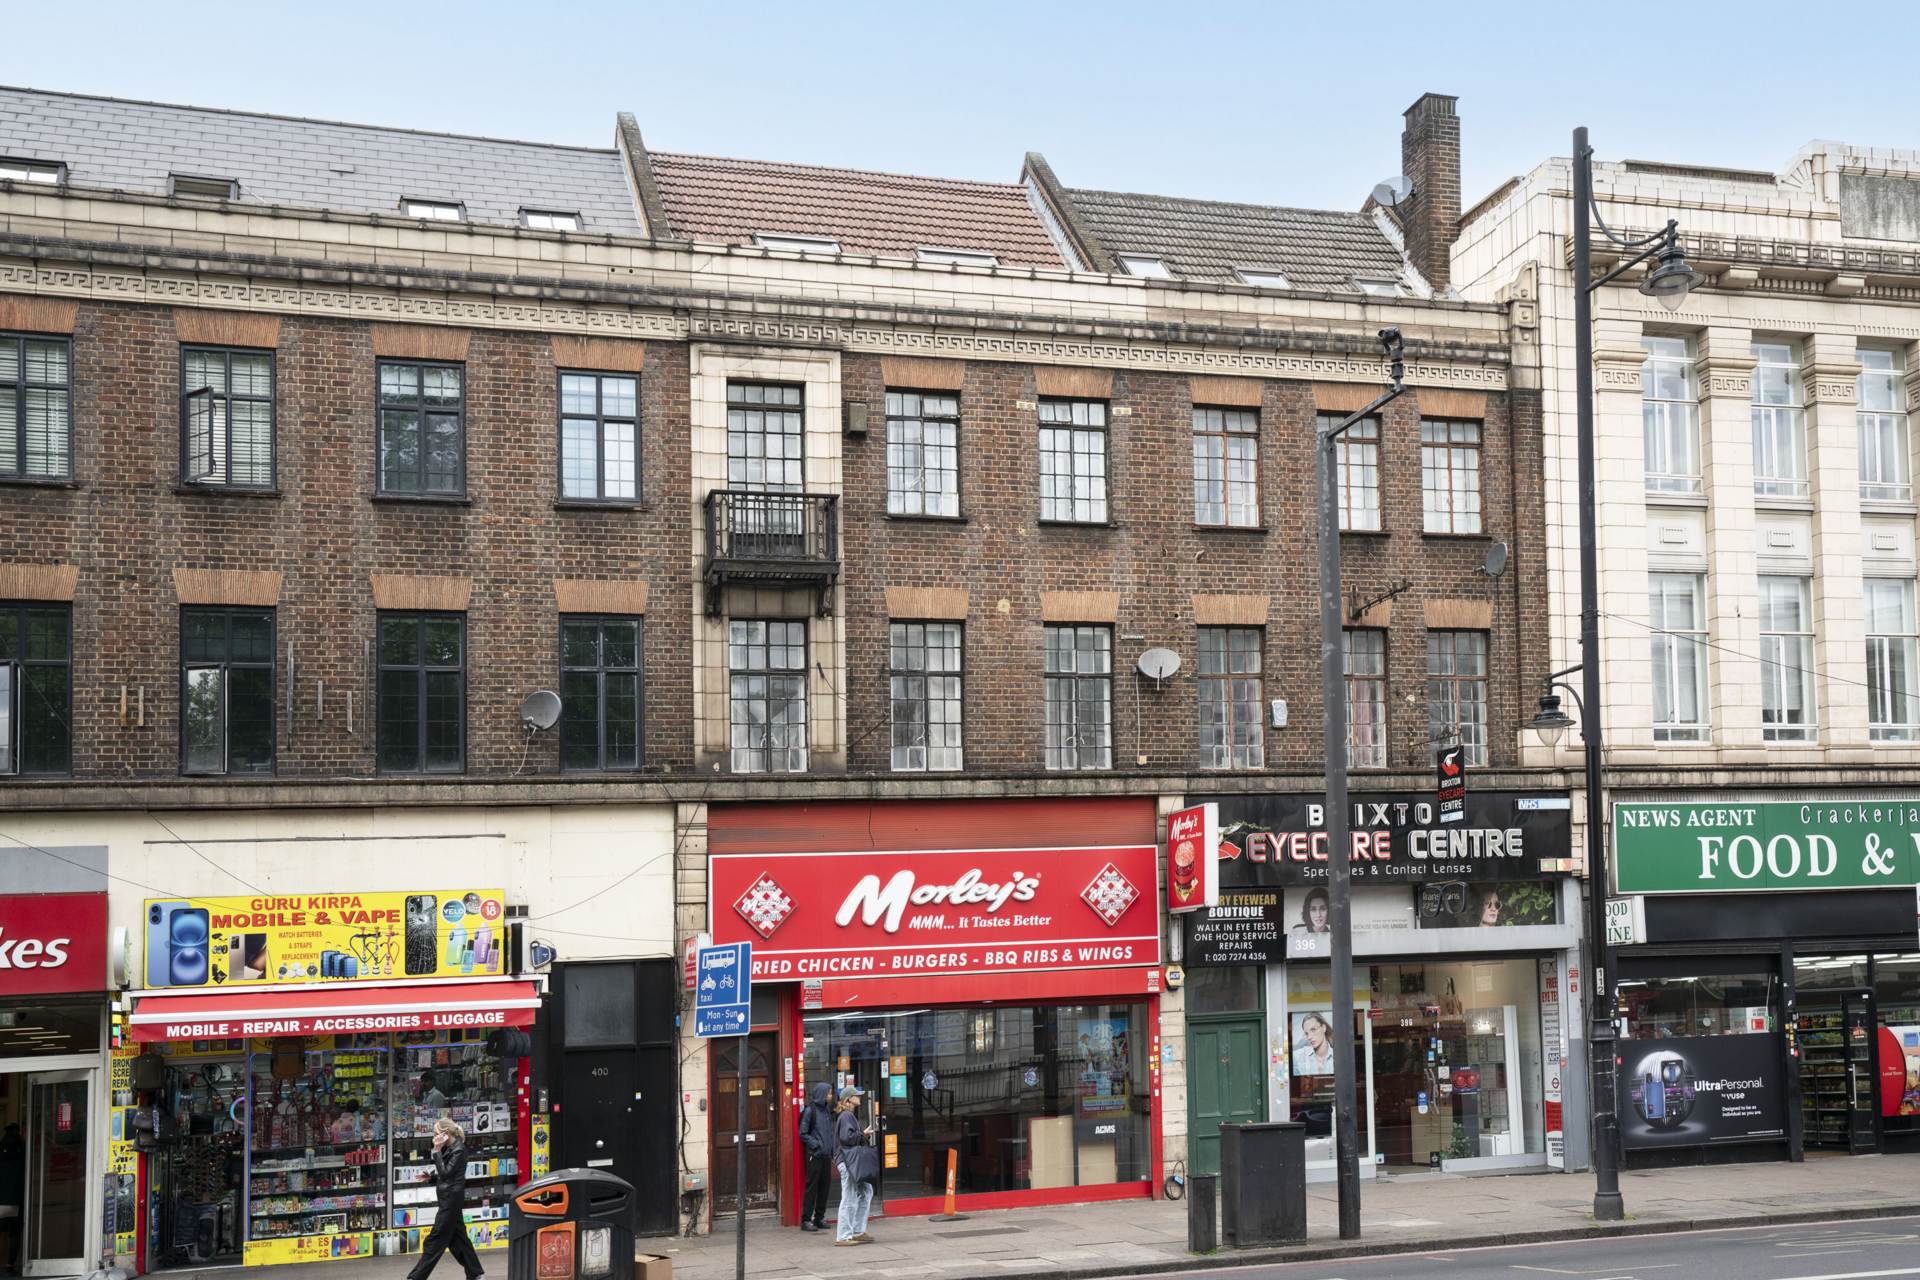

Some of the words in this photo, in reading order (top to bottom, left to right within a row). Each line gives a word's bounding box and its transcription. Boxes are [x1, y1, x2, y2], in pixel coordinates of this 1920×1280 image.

[1439, 788, 1465, 800] EYECARE
[1441, 799, 1463, 812] CENTRE
[1519, 800, 1538, 809] NHS
[1623, 810, 1681, 827] NEWS
[1686, 809, 1756, 827] AGENT
[1246, 831, 1391, 864] EYECRE
[1408, 828, 1523, 859] CENTRE
[1697, 834, 1837, 879] FOOD
[1861, 832, 1896, 876] &
[1386, 864, 1427, 875] Contact
[1433, 863, 1472, 874] Lenses
[251, 898, 301, 911] GURU
[308, 896, 362, 909] KIRPA
[835, 868, 1039, 933] Morley's
[1233, 894, 1277, 906] EYEWEAR
[1208, 906, 1264, 917] BOUTIQUE
[1605, 902, 1628, 917] OOD
[211, 913, 306, 929] MOBILE
[314, 911, 331, 925] &
[340, 909, 400, 925] VAPE
[959, 915, 969, 928] It
[972, 914, 1010, 928] Tastes
[1013, 912, 1052, 926] Better
[1196, 924, 1220, 932] WALK
[1236, 923, 1250, 931] EYE
[1253, 922, 1275, 930] TESTS
[1194, 933, 1213, 941] ONE
[1215, 932, 1240, 940] HOUR
[1242, 931, 1277, 940] SERVICE
[1607, 926, 1632, 942] INE
[1219, 941, 1253, 950] REPAIRS
[1295, 939, 1316, 951] 396
[752, 960, 792, 975] RIED
[797, 956, 874, 973] CHICKEN
[892, 952, 968, 969] BURGERS
[985, 950, 1018, 965] BBQ
[1023, 948, 1058, 964] RIBS
[1062, 948, 1073, 962] &
[1078, 946, 1133, 961] WINGS
[1212, 952, 1227, 961] 020
[1228, 952, 1247, 961] 7274
[1248, 952, 1267, 961] 4356
[700, 993, 713, 1003] taxi
[707, 1010, 721, 1019] Mon
[725, 1009, 738, 1018] Sun
[166, 1024, 229, 1038] MOBILE
[243, 1021, 300, 1034] REPAIR
[313, 1015, 420, 1031] ACCESSORIES
[433, 1012, 505, 1026] LUGGAGE
[703, 1023, 711, 1031] at
[712, 1022, 724, 1032] any
[725, 1021, 740, 1030] time
[592, 1067, 609, 1077] 400
